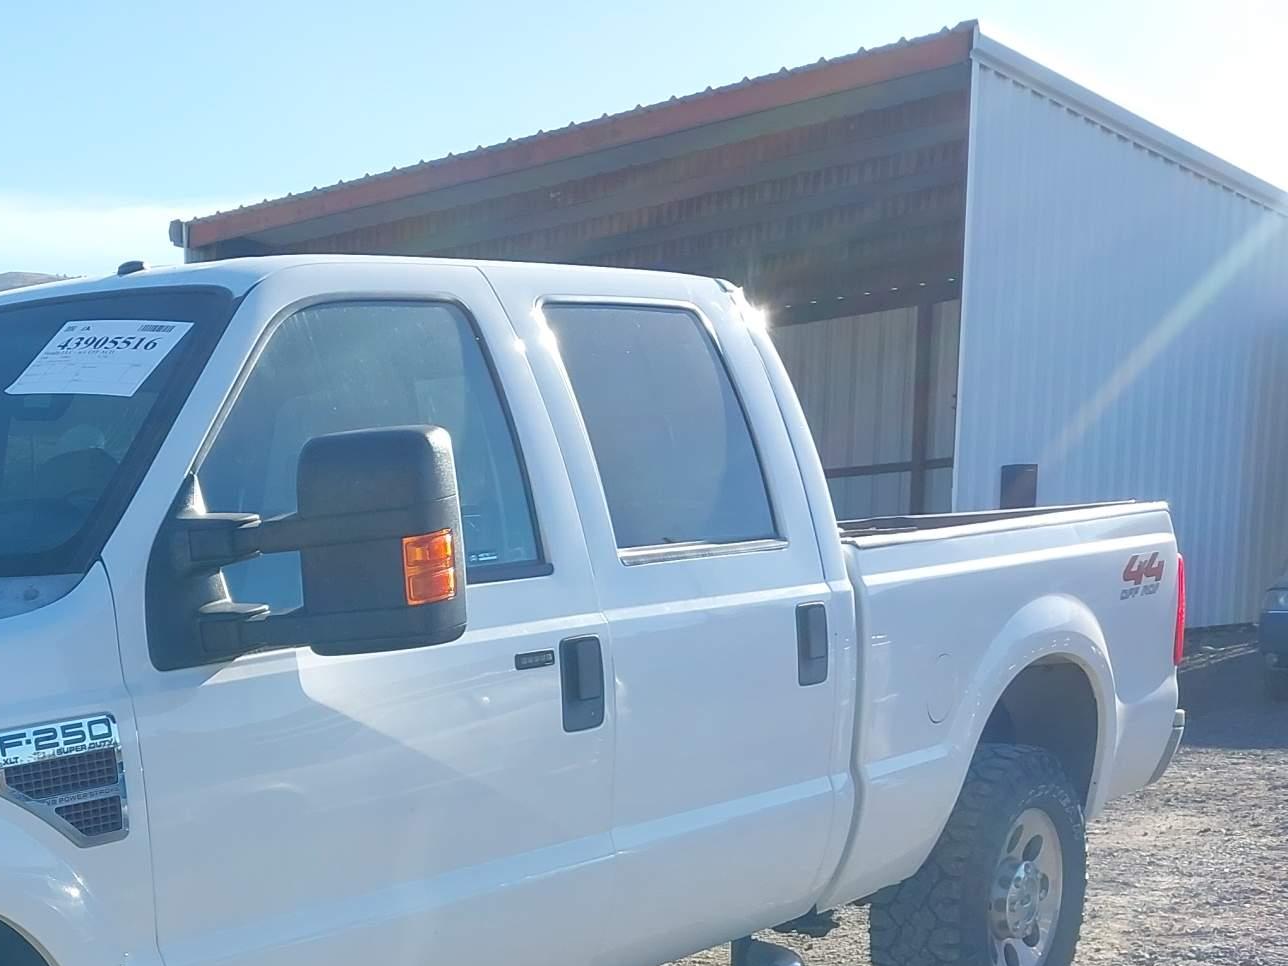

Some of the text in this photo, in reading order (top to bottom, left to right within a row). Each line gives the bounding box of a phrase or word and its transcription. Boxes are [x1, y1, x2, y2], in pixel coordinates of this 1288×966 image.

[57, 335, 162, 351] 43905516
[2, 757, 19, 766] XLT
[56, 744, 87, 756] SUPER
